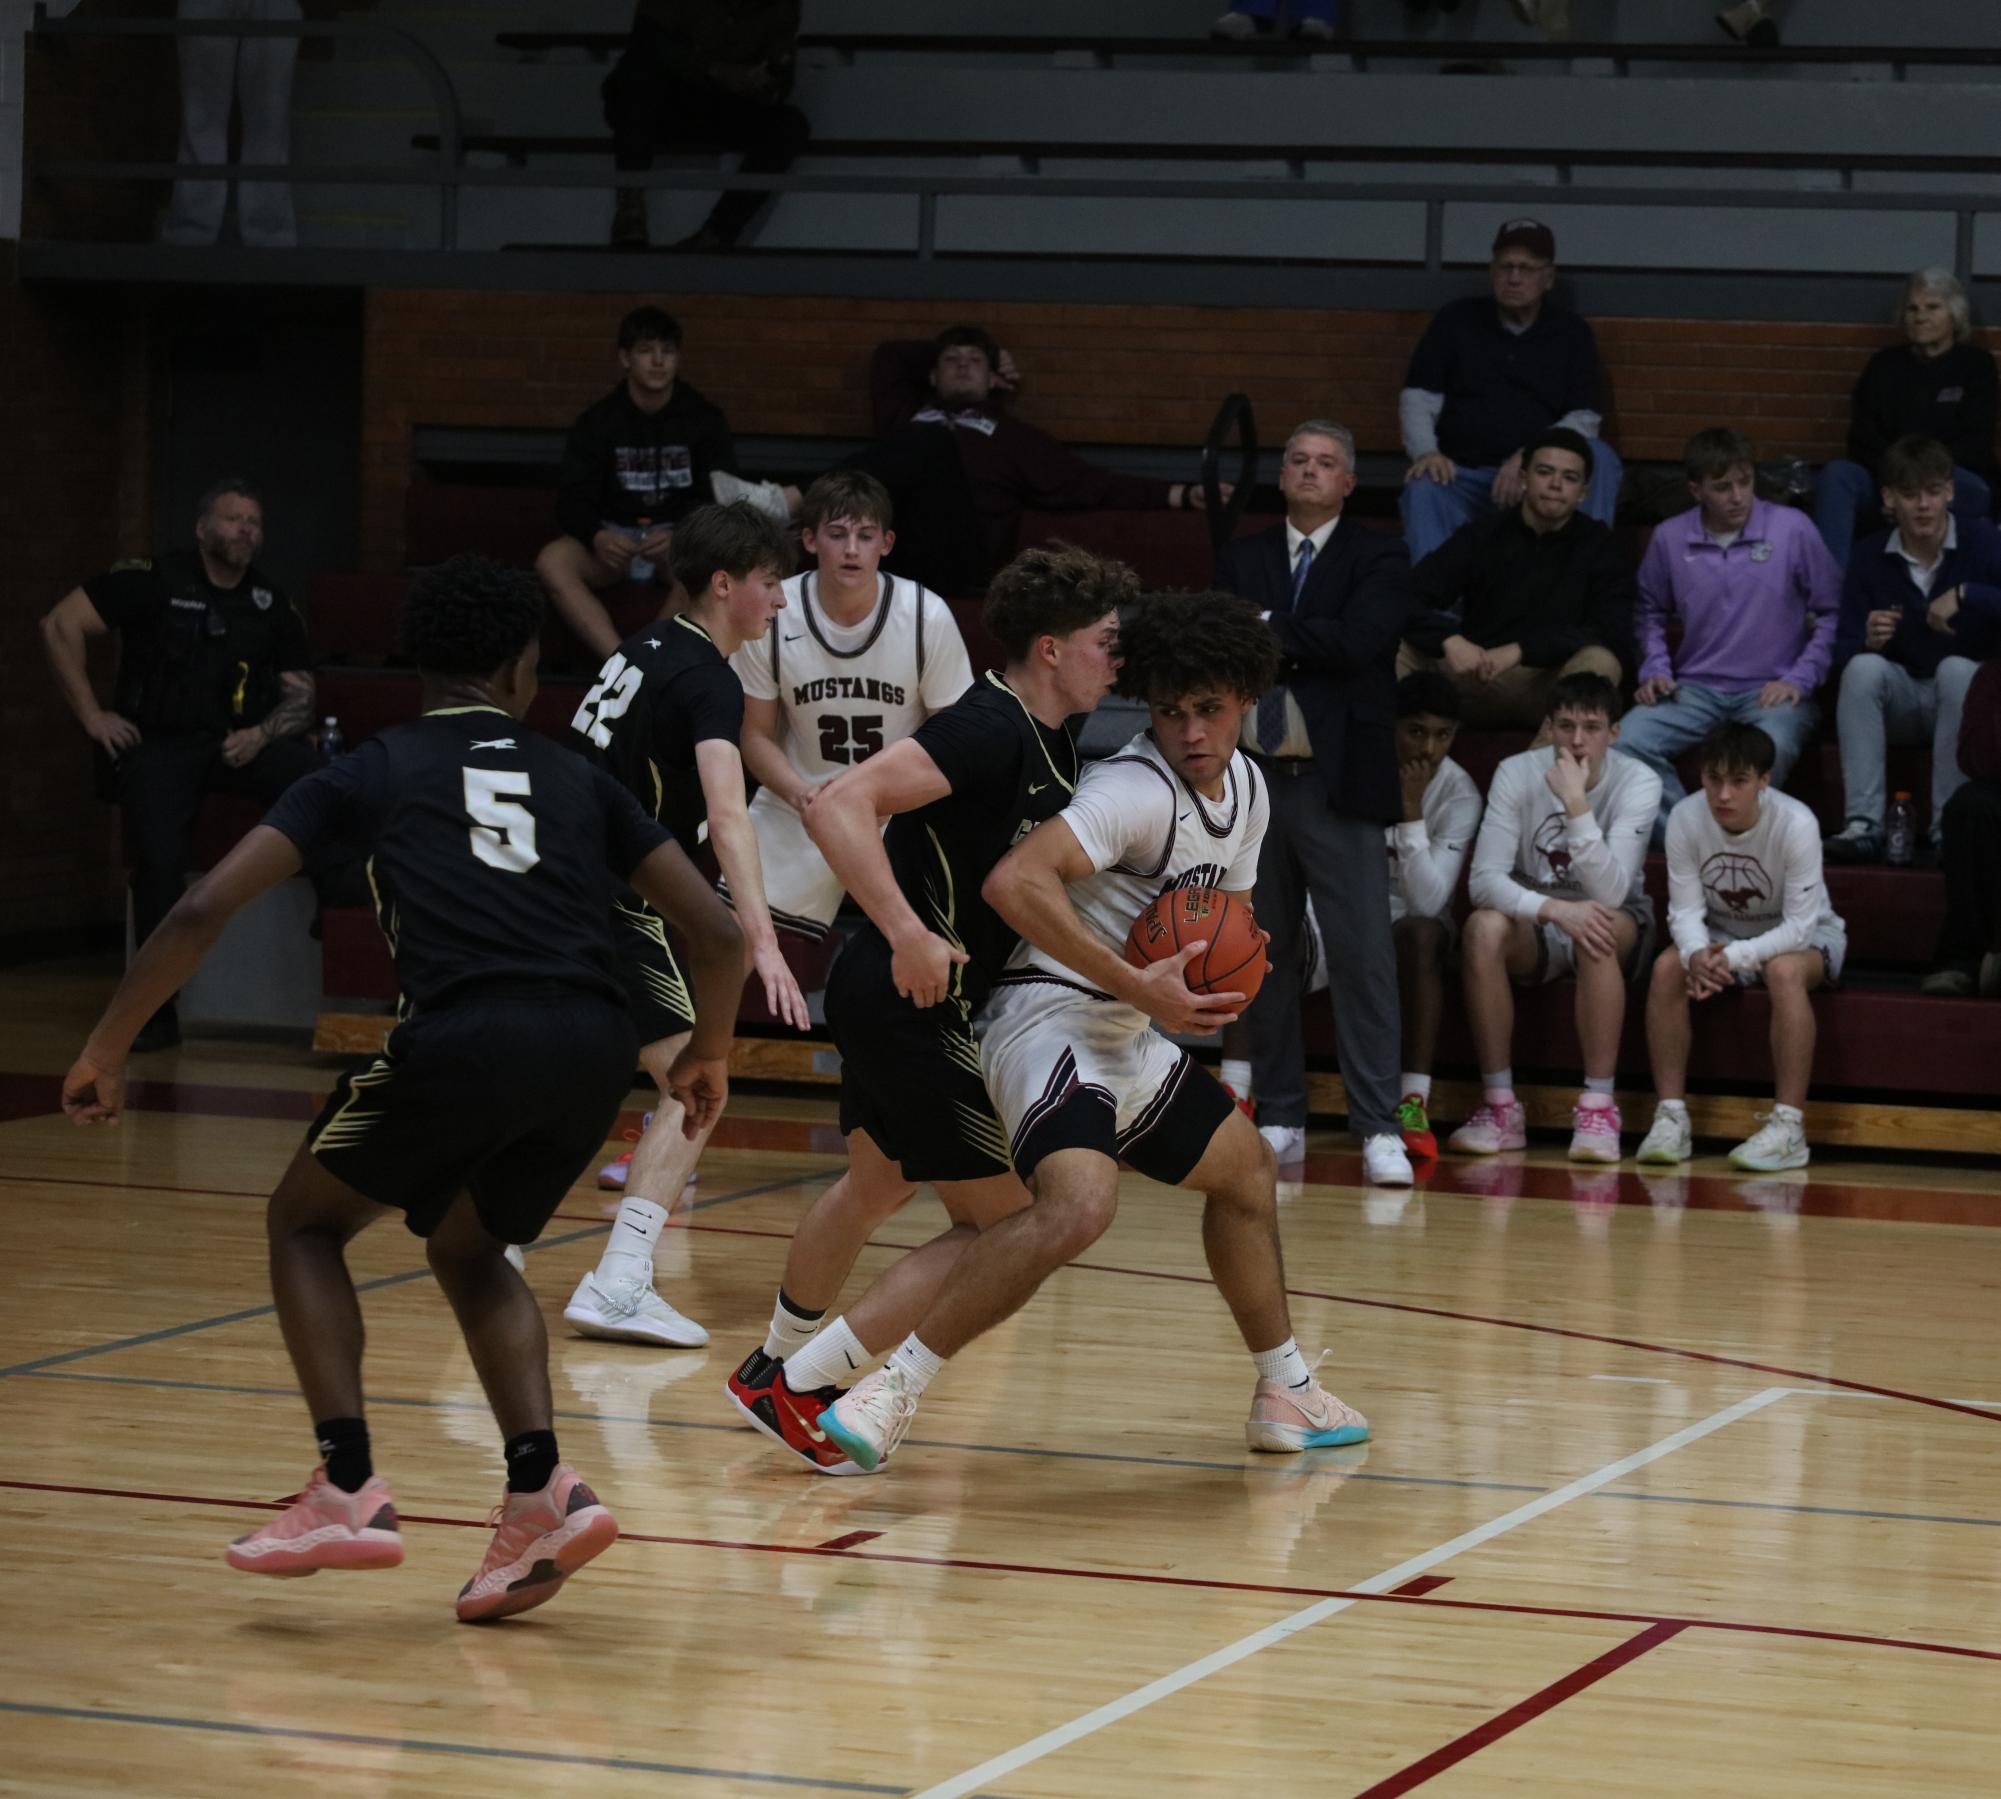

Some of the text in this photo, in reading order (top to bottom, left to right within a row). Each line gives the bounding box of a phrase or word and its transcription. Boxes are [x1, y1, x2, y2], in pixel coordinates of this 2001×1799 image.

[570, 651, 645, 751] 22
[793, 677, 905, 706] MUSTANGS
[817, 714, 884, 766] 25
[462, 765, 541, 874] 5
